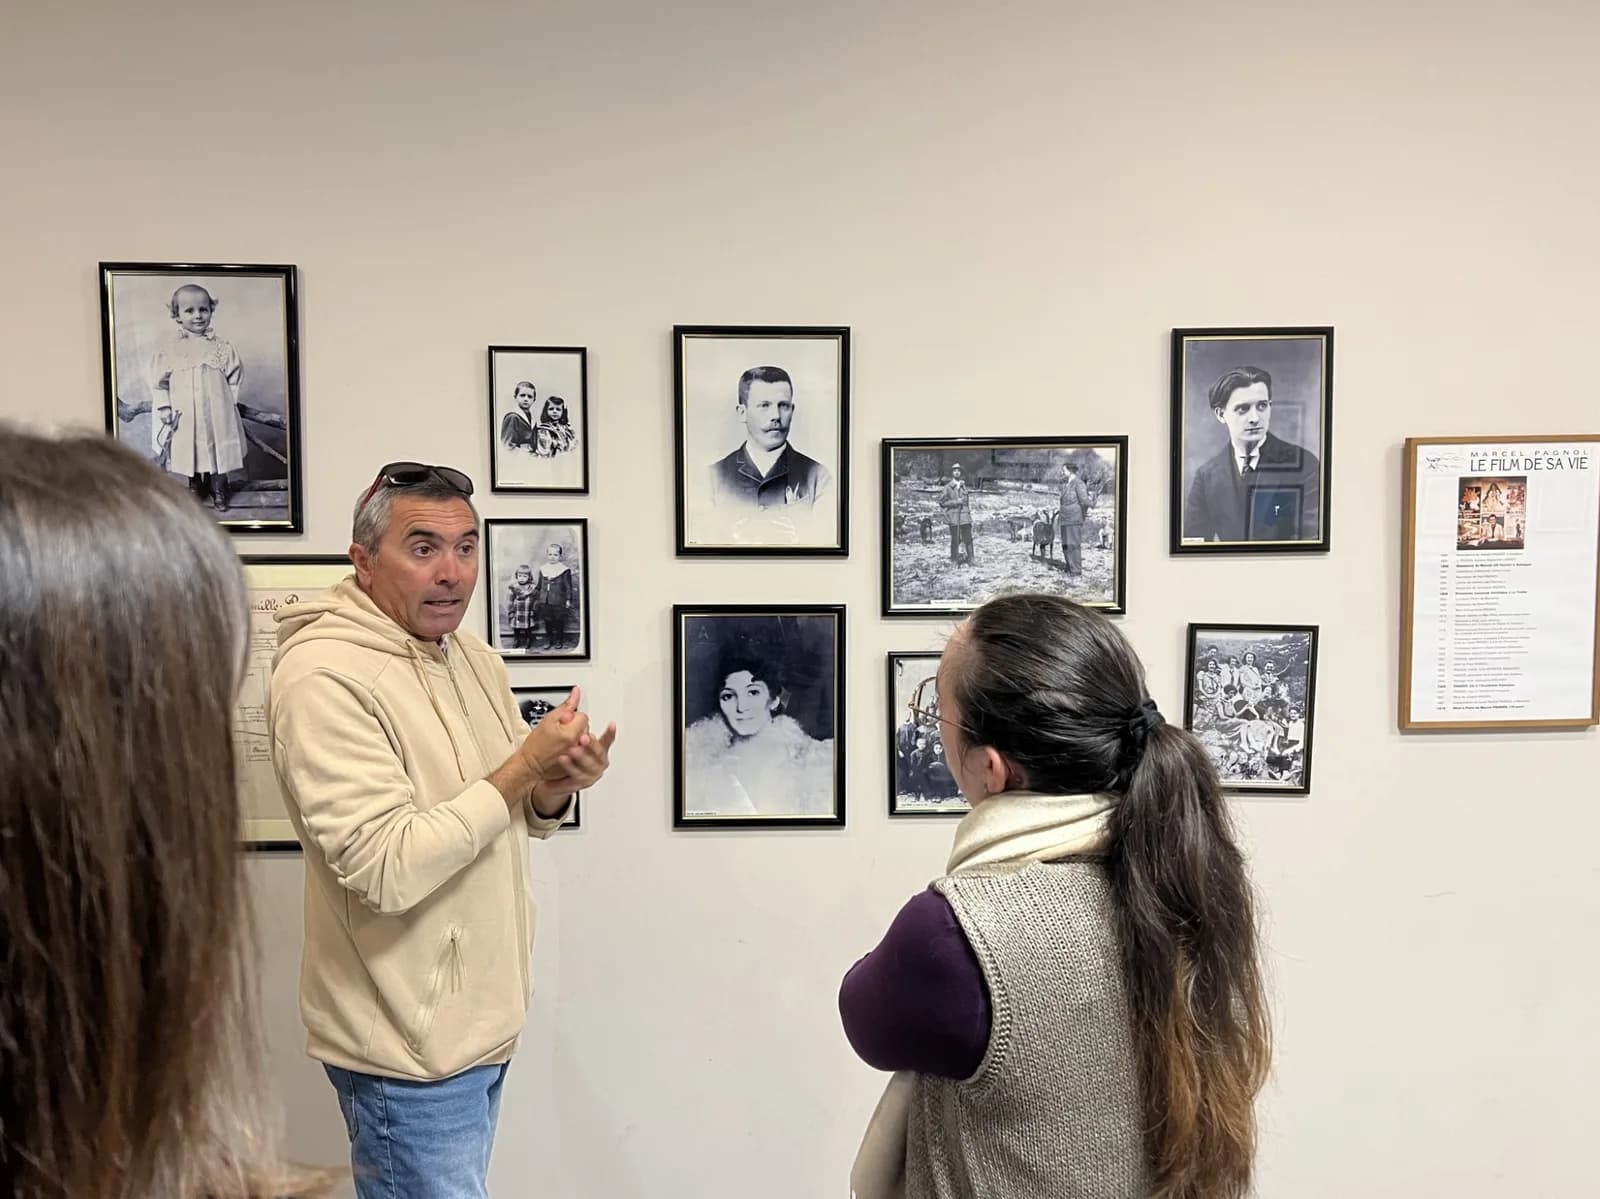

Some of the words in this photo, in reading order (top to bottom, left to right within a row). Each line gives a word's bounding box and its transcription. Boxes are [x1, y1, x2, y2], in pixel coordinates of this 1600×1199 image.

[1470, 450, 1524, 458] MARCEL
[1534, 449, 1588, 457] PAGNOL
[1470, 459, 1487, 472] LE
[1490, 458, 1520, 472] FILM
[1524, 458, 1543, 471] DE
[1546, 457, 1564, 471] SA
[1568, 456, 1588, 470] VIE
